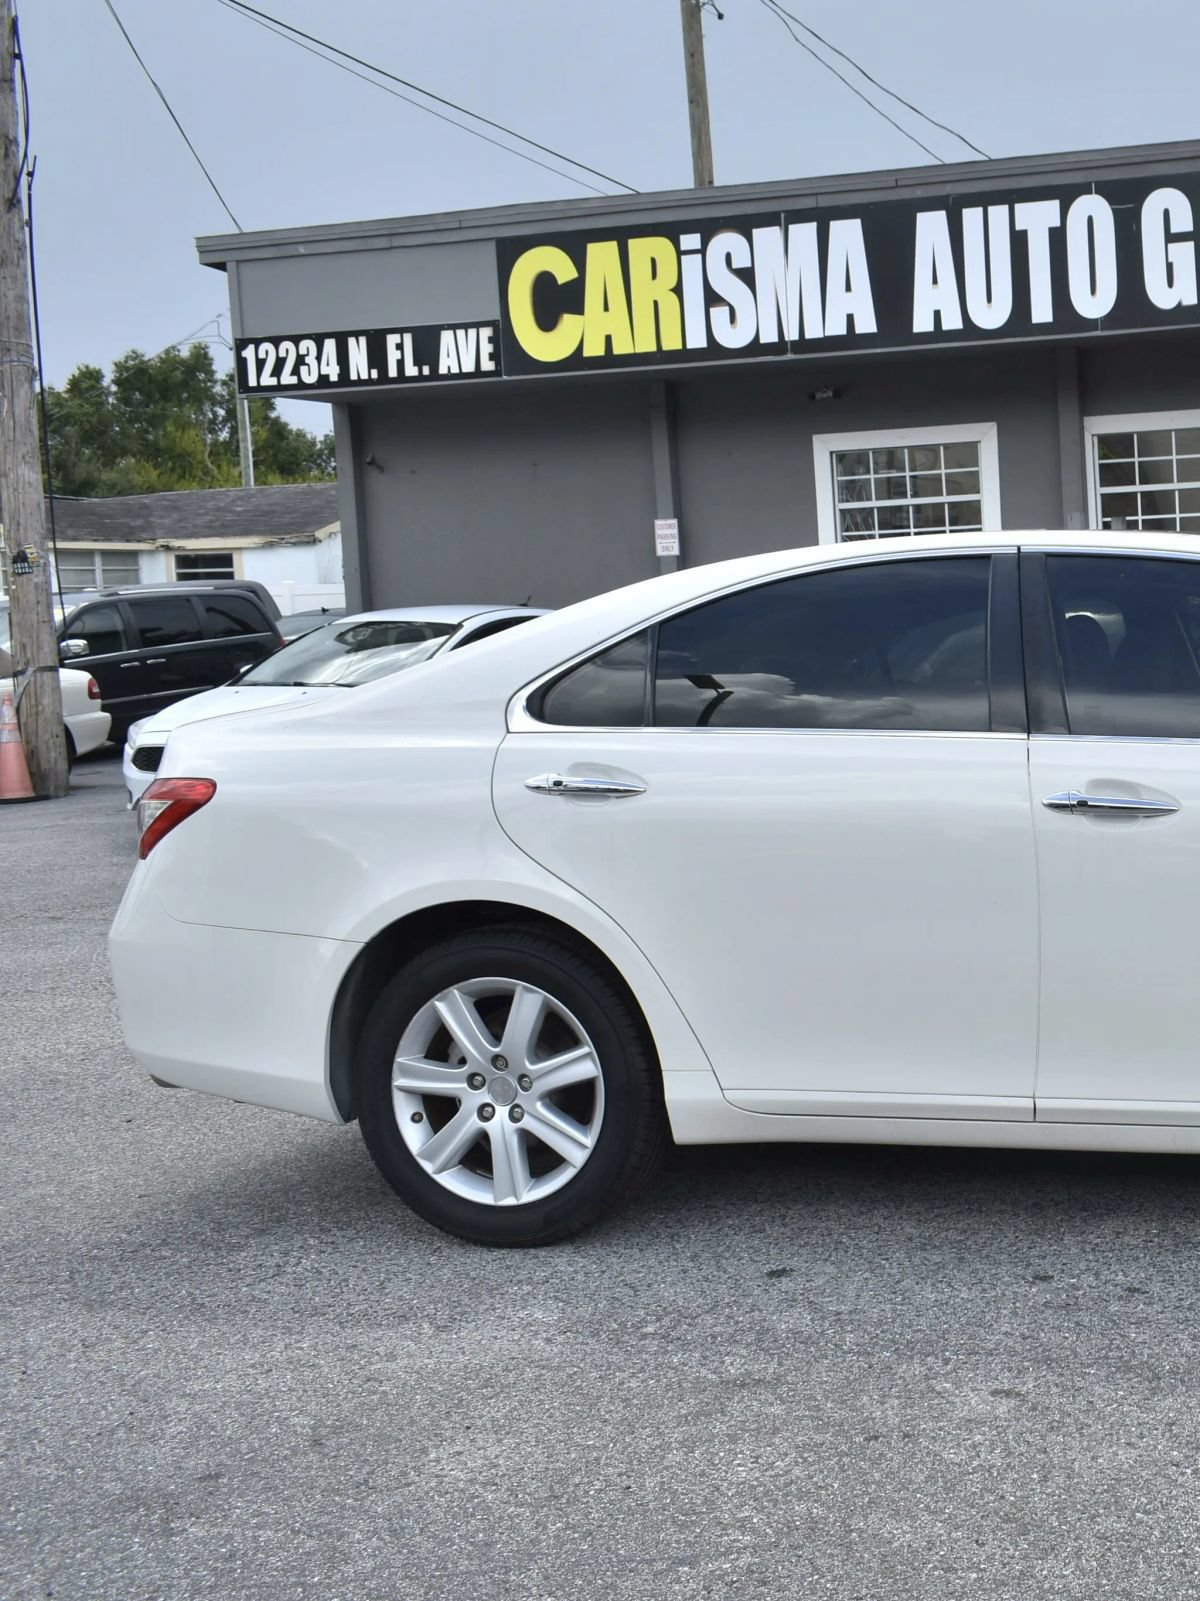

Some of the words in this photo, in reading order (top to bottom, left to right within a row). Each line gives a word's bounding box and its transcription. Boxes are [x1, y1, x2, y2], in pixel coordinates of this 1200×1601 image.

[507, 218, 877, 363] CARiSMA
[912, 193, 1118, 333] AUTO
[241, 338, 340, 387] 12234
[348, 335, 378, 381] N.
[386, 332, 430, 378] FL.
[438, 327, 496, 375] AVE
